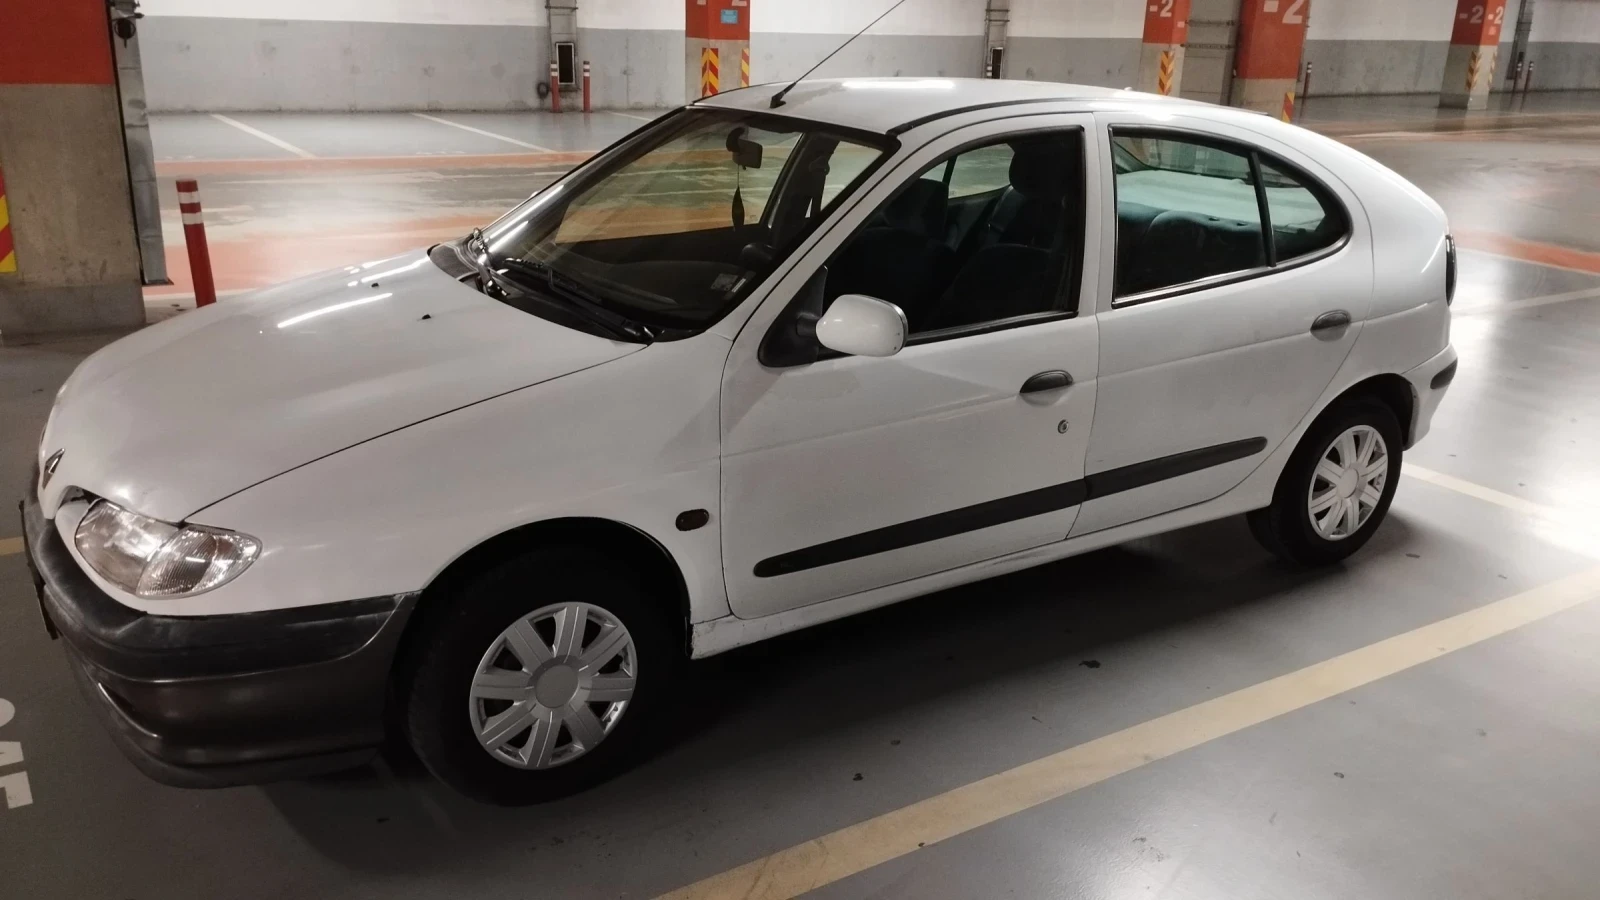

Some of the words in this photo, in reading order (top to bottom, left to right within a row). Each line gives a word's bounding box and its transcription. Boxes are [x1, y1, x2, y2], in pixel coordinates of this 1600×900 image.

[1149, 0, 1173, 17] -2
[1459, 5, 1484, 24] -2
[1488, 6, 1504, 24] -2
